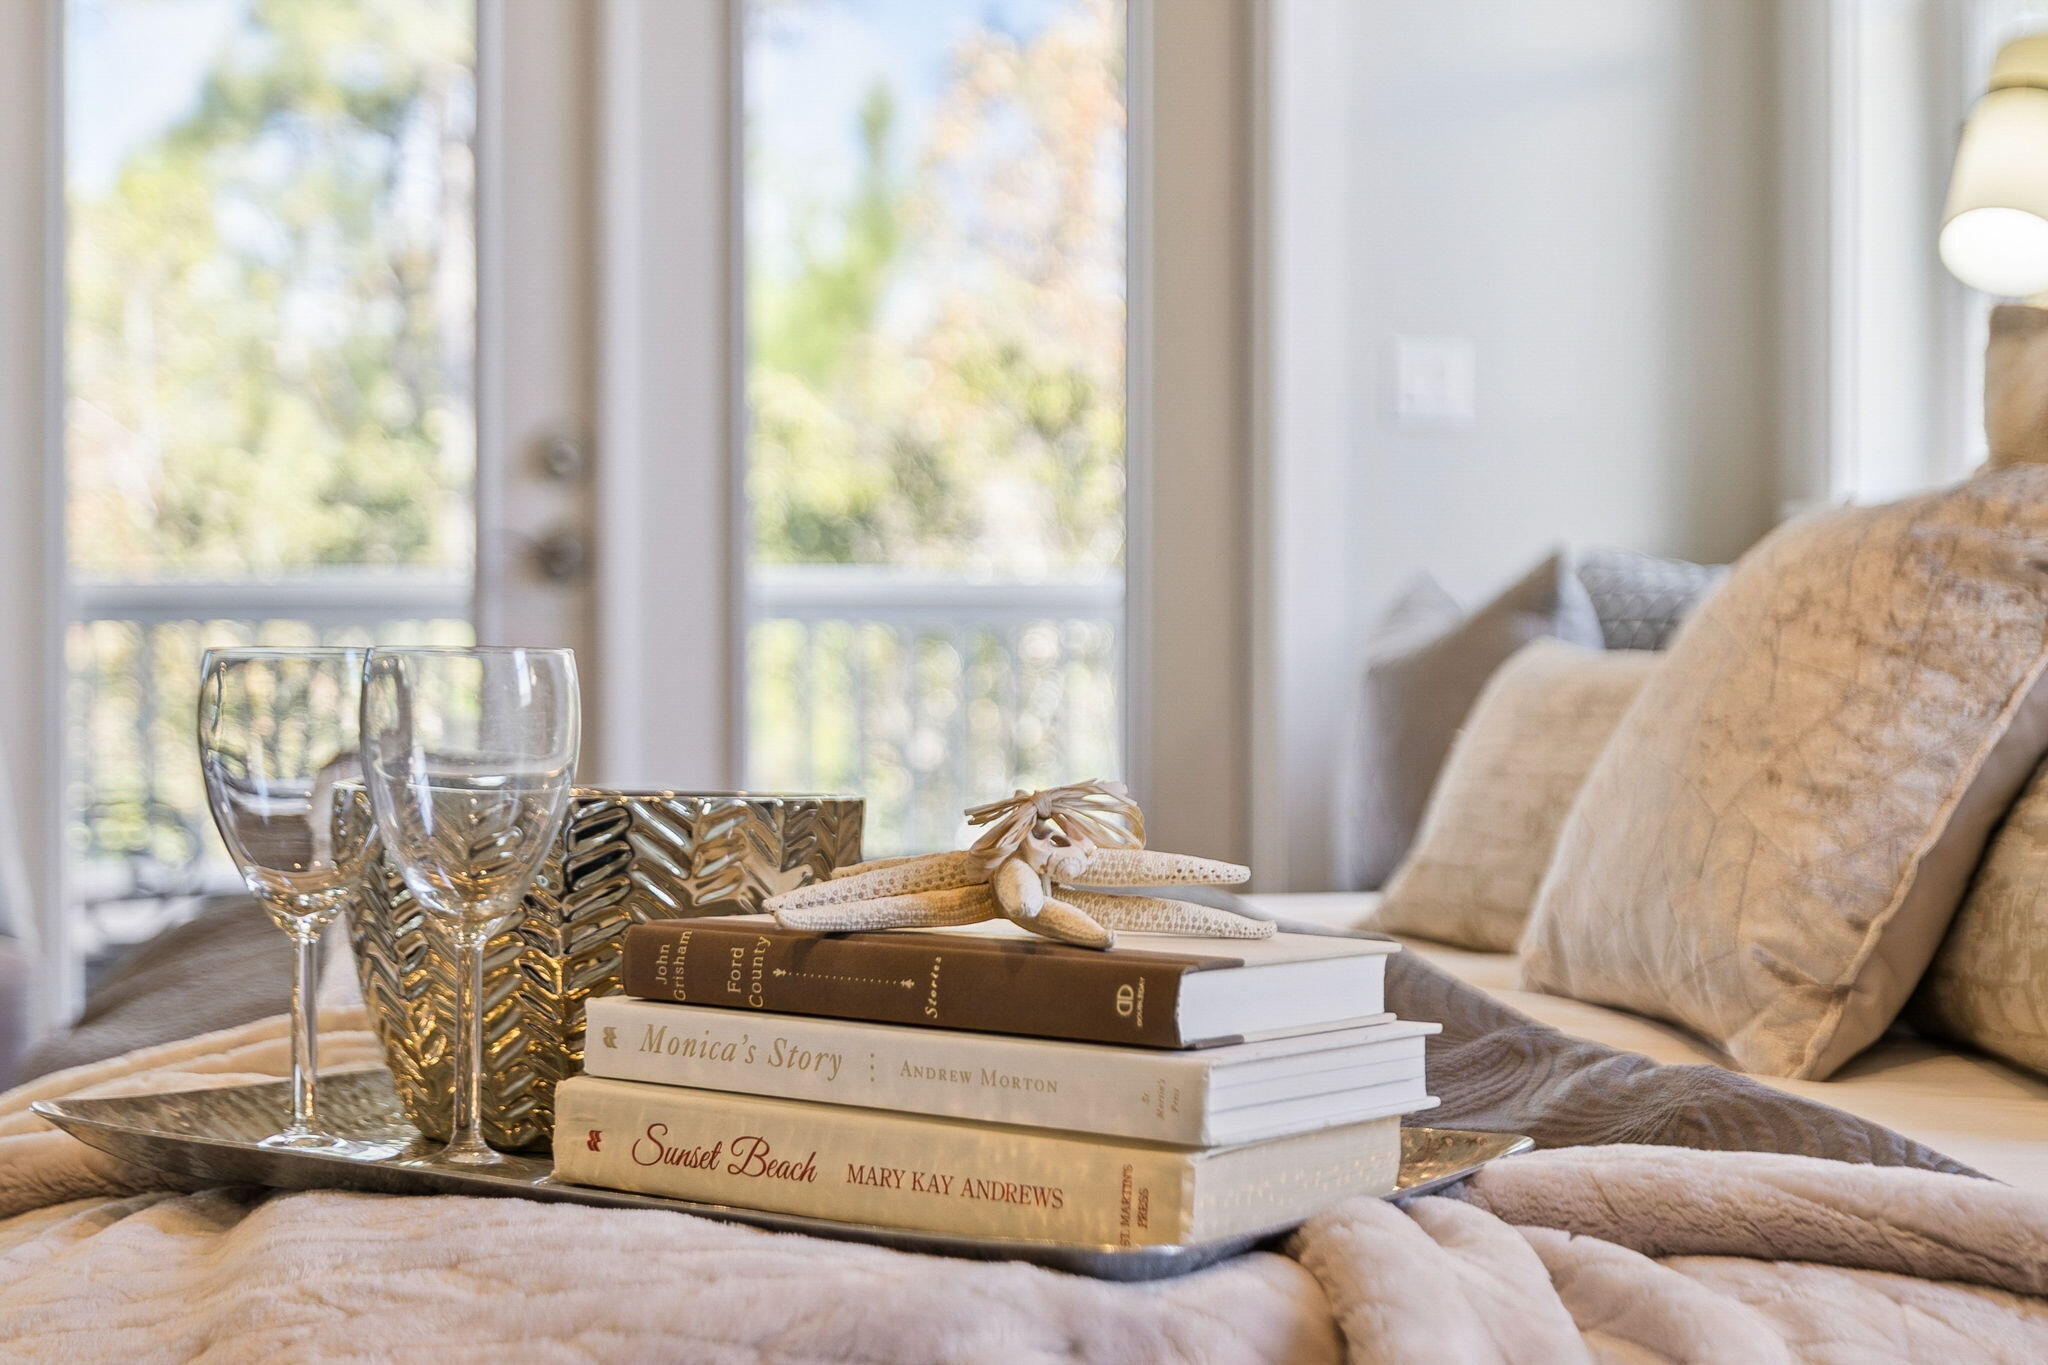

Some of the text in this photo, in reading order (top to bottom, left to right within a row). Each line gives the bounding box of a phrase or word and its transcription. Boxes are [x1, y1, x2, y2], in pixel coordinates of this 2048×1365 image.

[654, 943, 670, 986] John
[673, 929, 693, 1001] Grisham
[727, 947, 745, 993] Ford
[749, 935, 772, 1008] County
[924, 955, 943, 1019] Stories
[639, 1022, 843, 1082] Monica's Story
[900, 1060, 1059, 1094] ANDREW MORTON
[631, 1122, 818, 1183] Sunset Beach
[847, 1163, 1064, 1209] MARY KAY ANDREWS
[1137, 1187, 1149, 1229] PRESS
